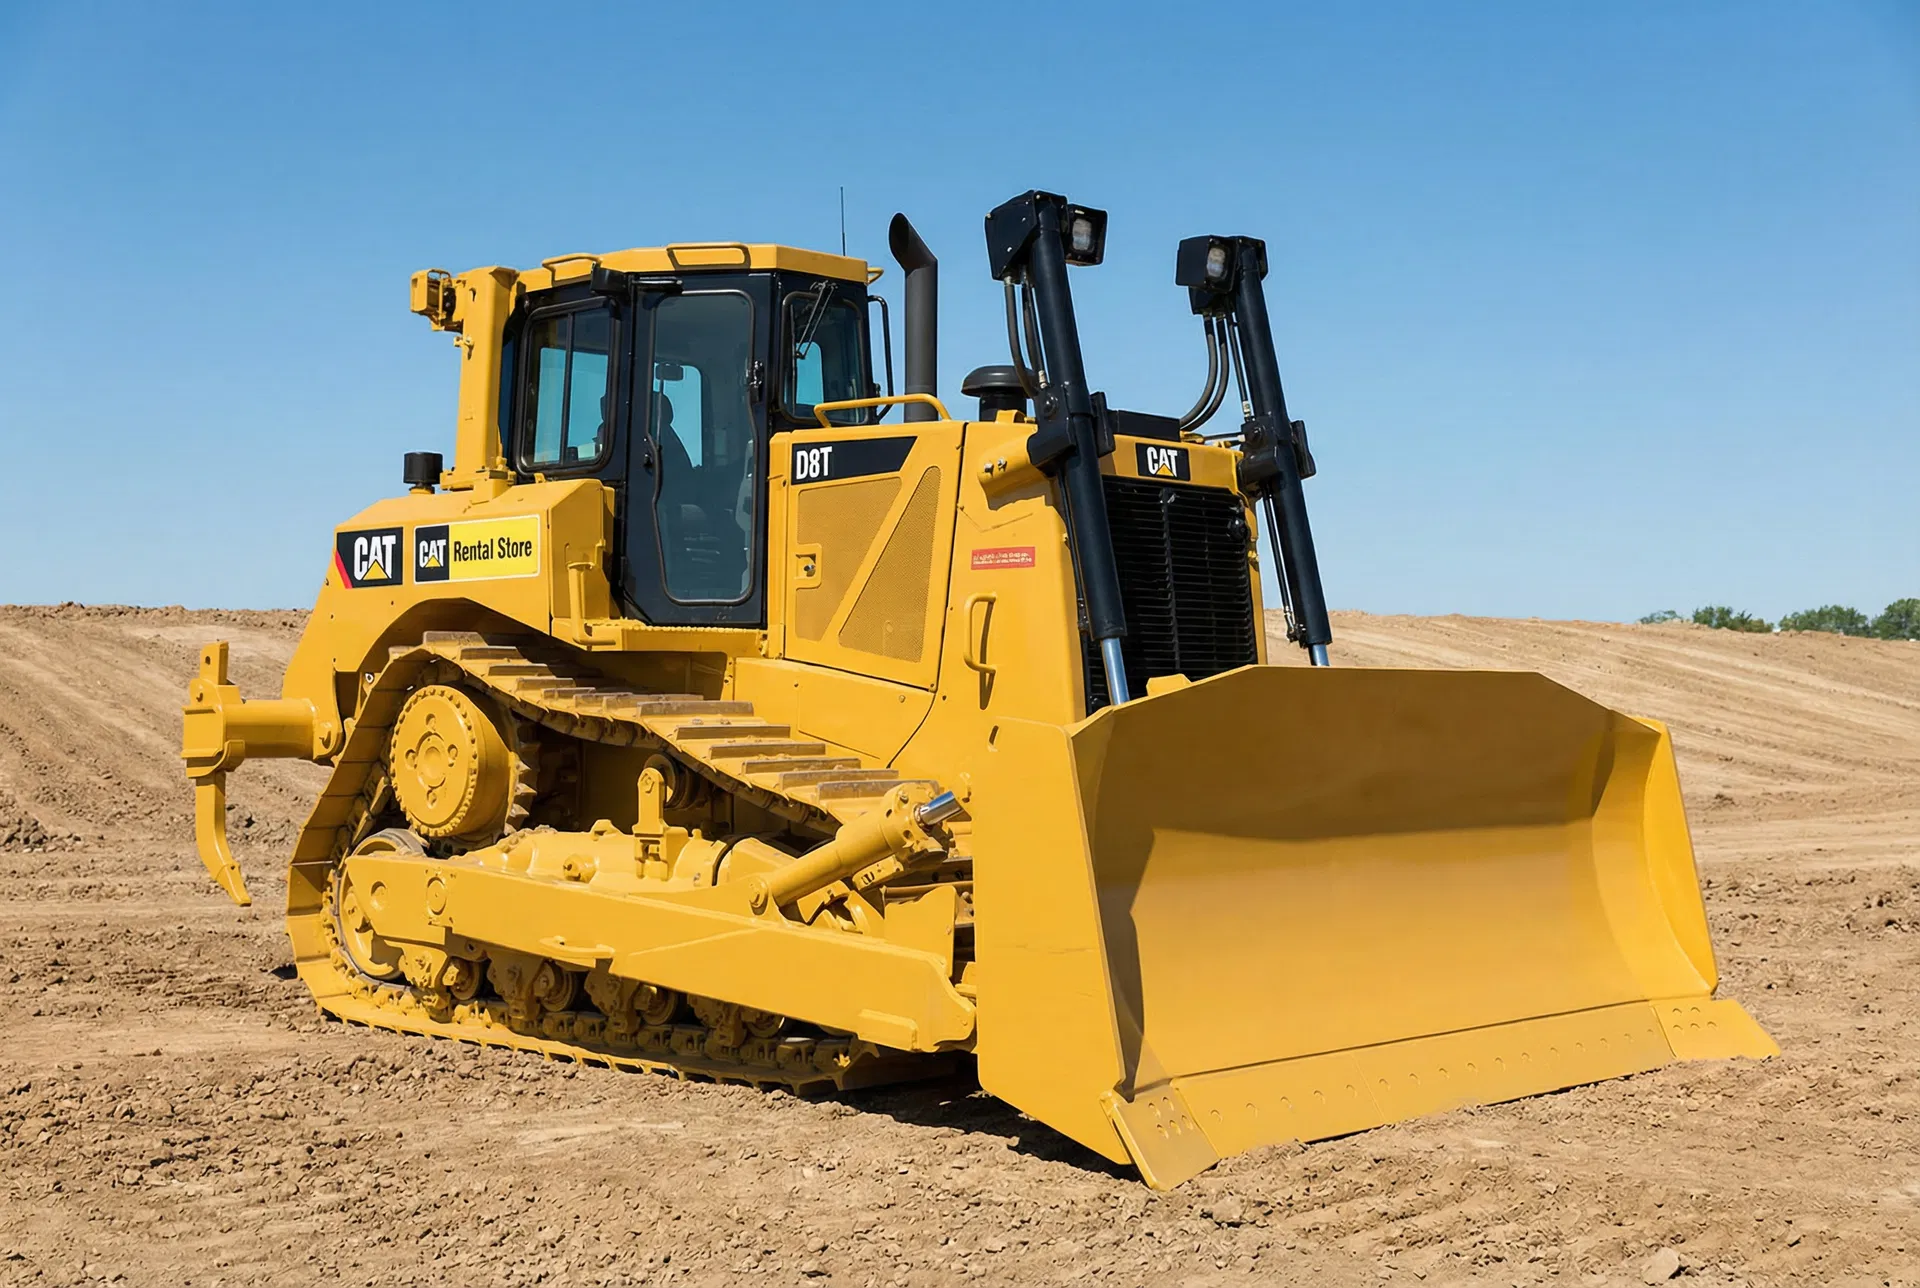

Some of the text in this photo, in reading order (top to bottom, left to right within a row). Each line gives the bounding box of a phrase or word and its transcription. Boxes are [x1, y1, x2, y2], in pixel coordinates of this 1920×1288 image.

[796, 446, 833, 480] D8T
[1147, 446, 1178, 477] CAT
[354, 535, 396, 580] CAT
[419, 539, 446, 568] CAT
[453, 537, 532, 562] Rental Store
